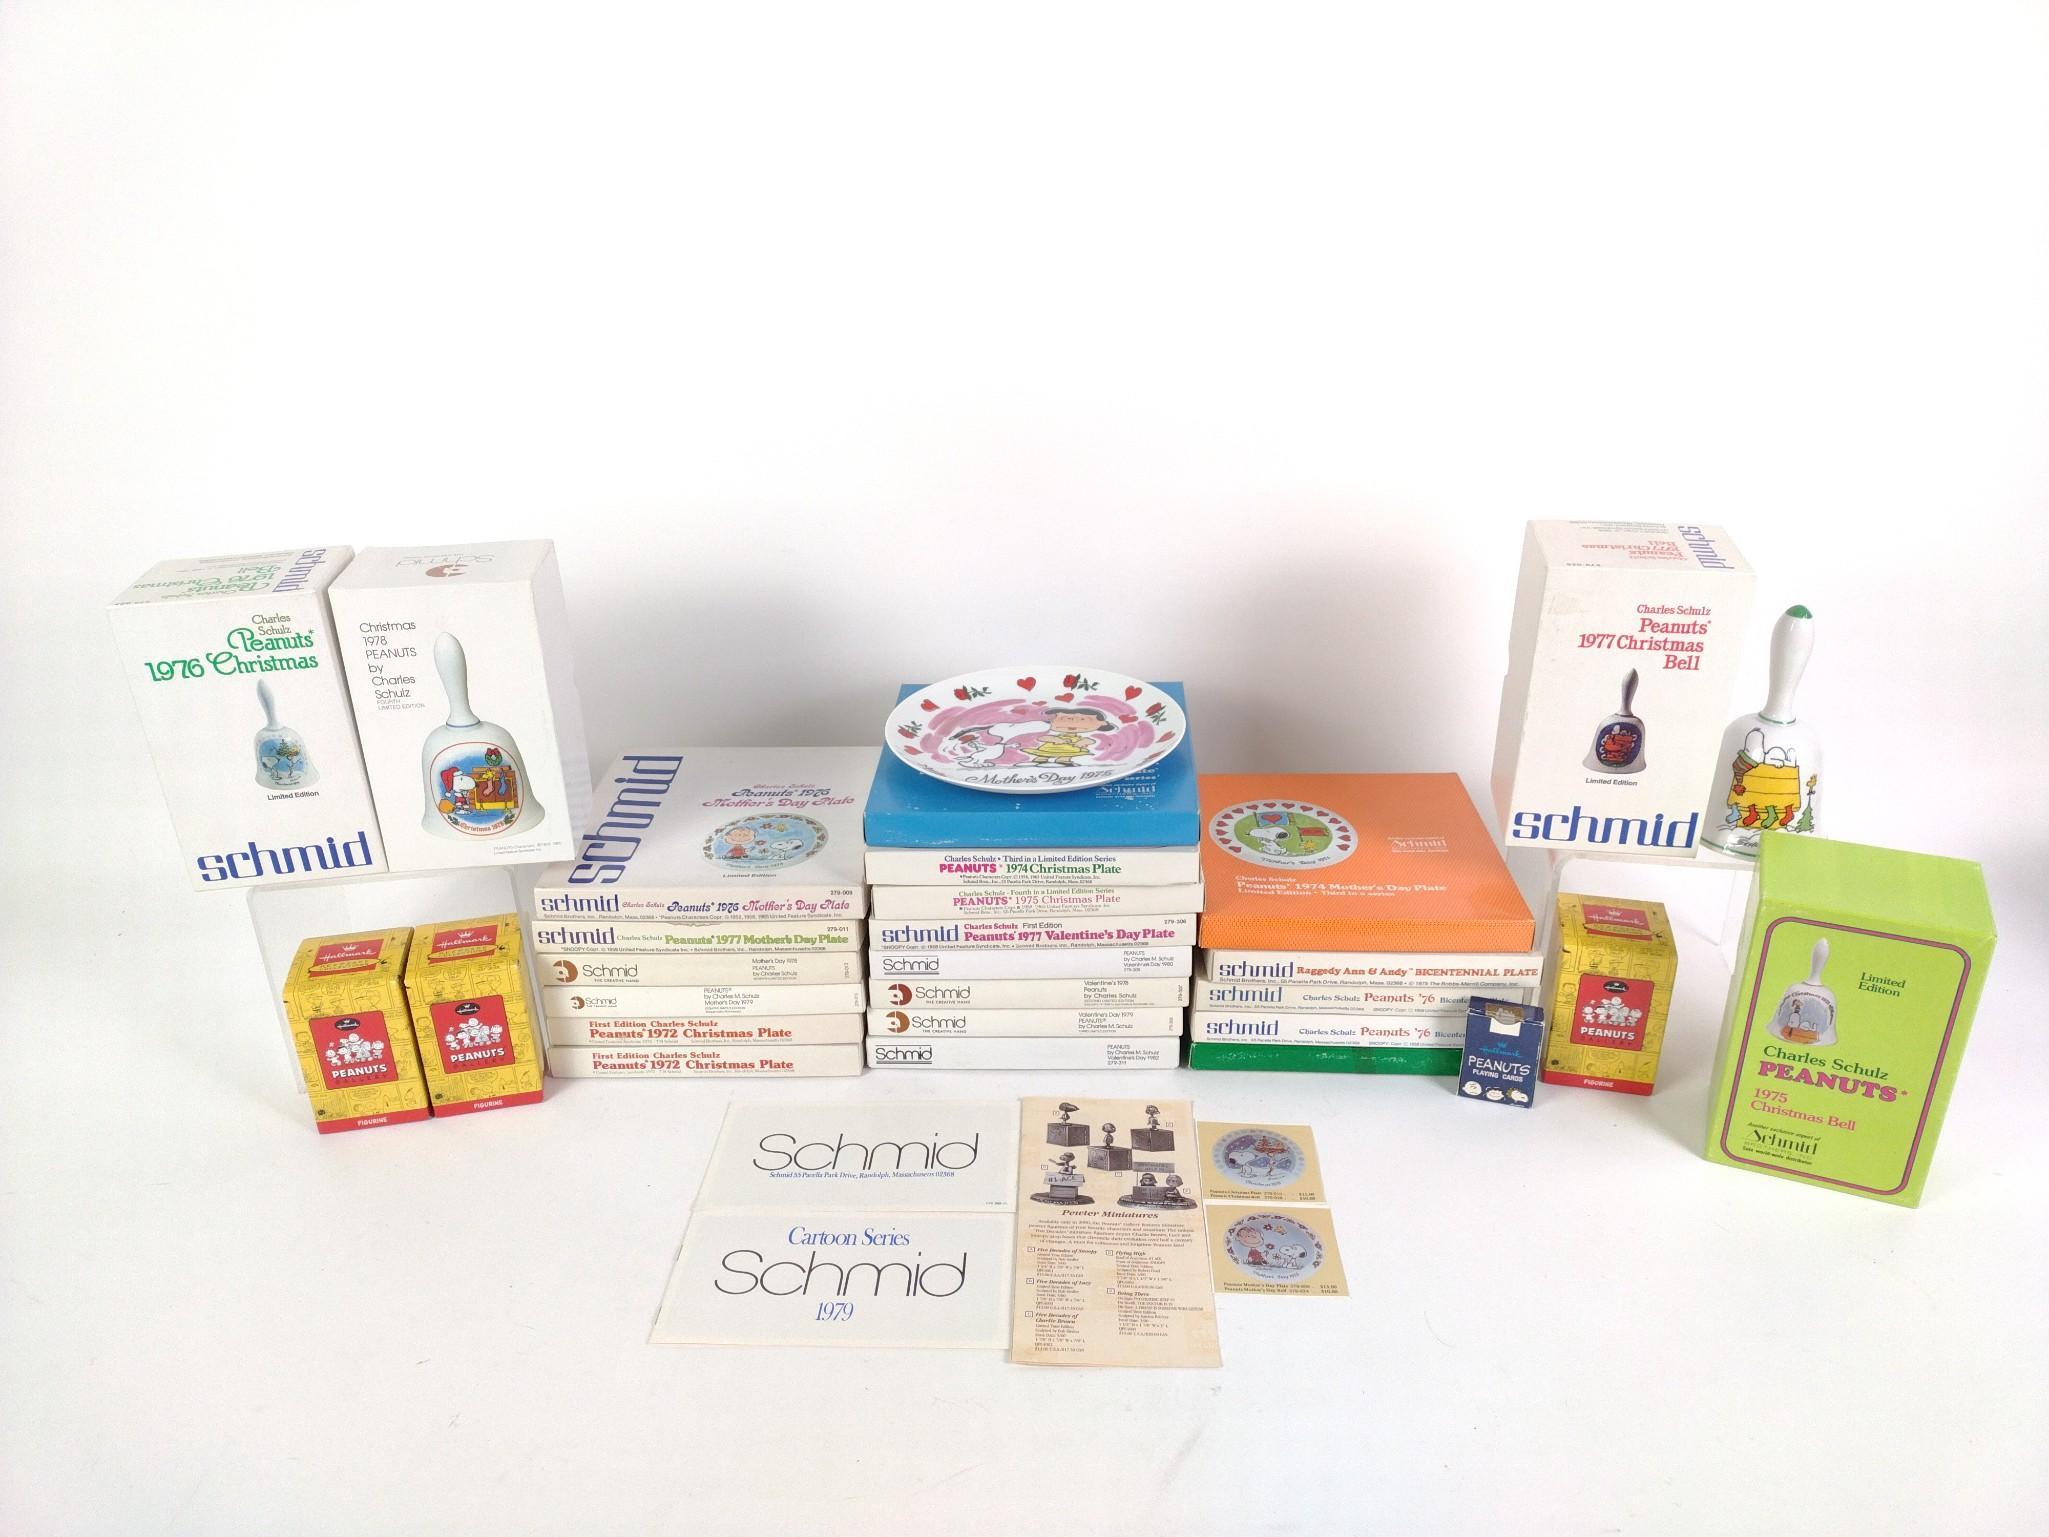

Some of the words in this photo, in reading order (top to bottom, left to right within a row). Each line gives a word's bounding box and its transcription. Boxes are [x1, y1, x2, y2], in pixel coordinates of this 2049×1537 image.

[1637, 605, 1675, 615] Charles
[1677, 606, 1711, 615] Schulz
[252, 614, 290, 624] Charles
[258, 626, 291, 635] Schulz
[360, 621, 416, 632] Christmas
[1638, 618, 1708, 634] Peanuts
[227, 628, 313, 652] Peanuts
[363, 636, 387, 646] 1978
[1578, 634, 1616, 649] 1977
[1617, 635, 1704, 653] Christmas
[366, 648, 417, 660] PEANUTS
[145, 659, 204, 681] 1976
[206, 652, 318, 675] Christmas
[368, 663, 383, 673] by
[1663, 655, 1700, 671] Bell
[372, 676, 415, 686] Charles
[375, 689, 411, 699] Schulz
[965, 774, 1037, 785] Mother's
[1038, 773, 1077, 785] Day
[1585, 778, 1611, 786] Limited
[1613, 779, 1638, 787] Edition
[703, 798, 775, 807] Mother's
[778, 798, 808, 808] Day
[812, 797, 855, 806] Plate
[567, 755, 684, 884] schmid
[1512, 806, 1699, 849] schmid
[197, 831, 372, 881] schmid
[940, 864, 997, 873] PEANUTS
[1006, 864, 1028, 873] 1974
[1030, 864, 1090, 873] Christmas
[1093, 864, 1121, 873] Plate
[541, 894, 619, 912] schmid
[667, 901, 711, 913] Peanuts
[742, 899, 792, 911] Mother's
[795, 900, 817, 913] Day
[820, 899, 850, 910] Plate
[953, 897, 1008, 906] PEANUTS
[1042, 896, 1092, 904] Christmas
[1096, 895, 1120, 903] Plate
[1587, 915, 1644, 926] Hallmark
[538, 927, 615, 944] schmid
[664, 934, 713, 945] Peanuts
[716, 935, 741, 944] 1977
[744, 934, 792, 944] Mother's
[794, 934, 817, 945] Day
[819, 934, 848, 943] Plate
[882, 924, 958, 942] schmid
[964, 932, 1014, 941] Peanuts
[1018, 932, 1042, 941] 1977
[1045, 930, 1113, 940] Valentine's
[1116, 930, 1141, 940] Day
[1142, 929, 1175, 938] Plate
[437, 936, 492, 947] Hallmark
[319, 950, 376, 961] Hallmark
[583, 964, 638, 977] Schmid
[883, 958, 939, 970] Schmid
[1220, 961, 1293, 977] schmid
[1297, 967, 1342, 976] Raggedy
[1379, 968, 1408, 978] Andy
[1415, 969, 1499, 977] BICENTENNIAL
[1861, 972, 1906, 988] Limited
[916, 986, 970, 998] Schmid
[1210, 986, 1282, 1002] schmid
[1365, 993, 1414, 1003] Peanuts
[1418, 993, 1435, 1004] '76
[1858, 981, 1900, 997] Edition
[912, 1016, 966, 1028] Schmid
[1207, 1019, 1278, 1035] schmid
[1361, 1027, 1410, 1037] Peanuts
[1414, 1028, 1430, 1038] '76
[590, 1029, 643, 1038] Peanuts
[647, 1029, 677, 1038] 1972
[683, 1028, 753, 1038] Christmas
[758, 1028, 792, 1037] Plate
[1581, 1026, 1635, 1040] PEANUTS
[450, 1048, 505, 1063] PEANUTS
[876, 1047, 932, 1060] Schmid
[593, 1061, 646, 1070] Peanuts
[651, 1060, 680, 1069] 1972
[686, 1060, 755, 1069] Christmas
[760, 1060, 794, 1069] Plate
[1469, 1056, 1530, 1075] PEANUTS
[1764, 1045, 1826, 1067] Charles
[1832, 1059, 1888, 1080] Schulz
[332, 1064, 387, 1078] PEANUTS
[1473, 1069, 1498, 1078] PLAYING
[1584, 1079, 1614, 1088] FIGURINE
[1758, 1061, 1897, 1102] PEANUTS
[1754, 1088, 1788, 1103] 1975
[474, 1100, 503, 1109] FIGURINE
[358, 1117, 387, 1126] FIGURINE
[1751, 1101, 1823, 1124] Christmas
[1828, 1116, 1855, 1131] Bell
[1747, 1130, 1817, 1154] Schmid
[753, 1133, 979, 1170] Schmid
[1062, 1209, 1099, 1217] Pewter
[1102, 1210, 1158, 1219] Miniatures
[788, 1227, 857, 1246] Cartoon
[861, 1228, 911, 1246] Series
[715, 1250, 967, 1297] Schmid
[816, 1301, 854, 1321] 1979
